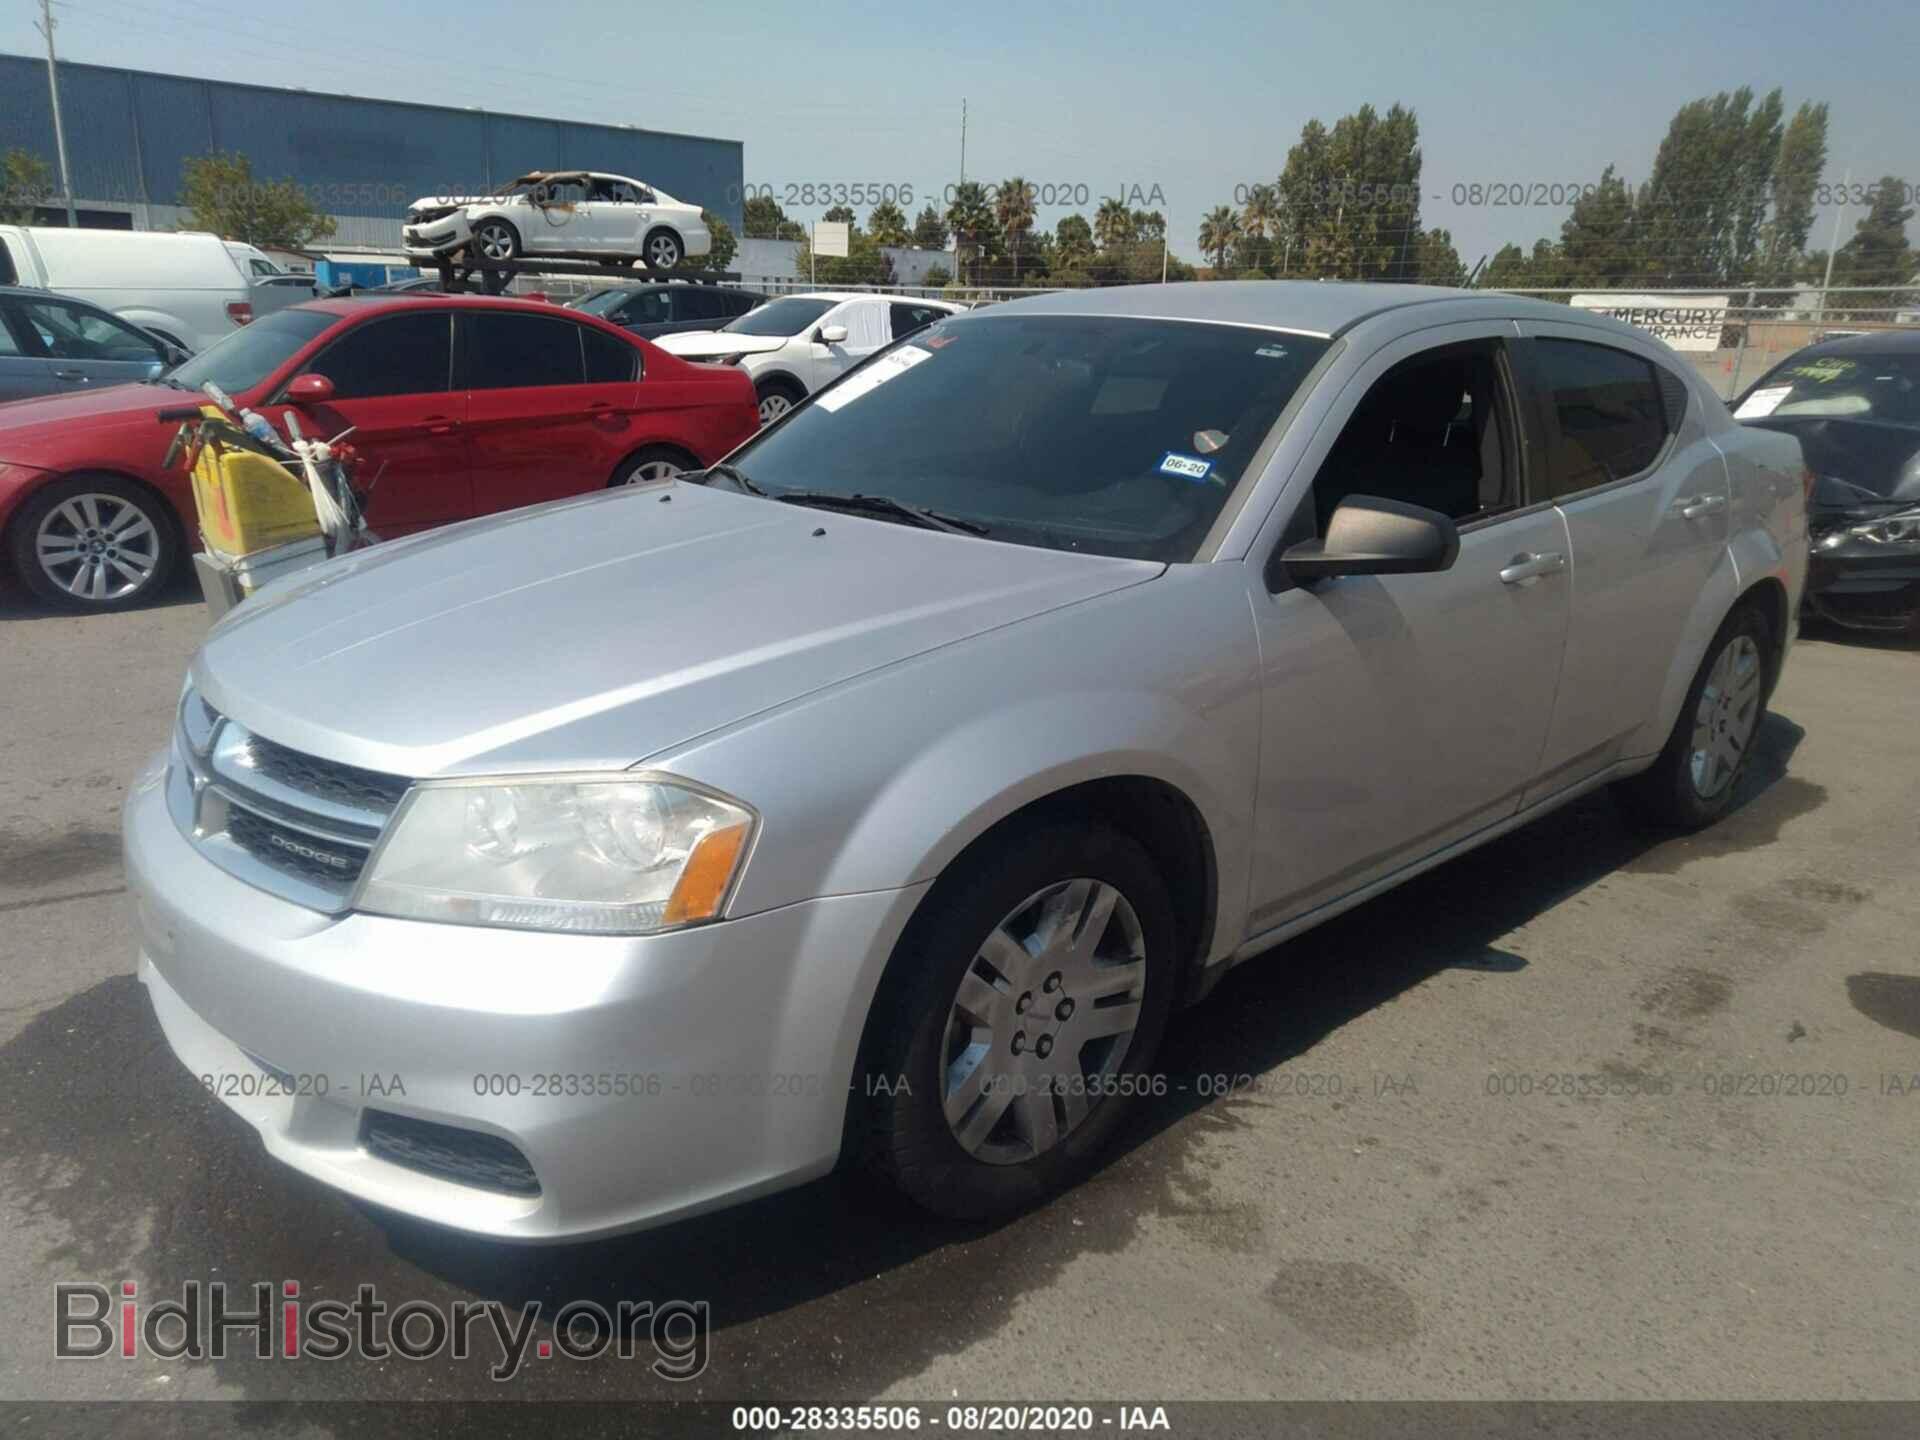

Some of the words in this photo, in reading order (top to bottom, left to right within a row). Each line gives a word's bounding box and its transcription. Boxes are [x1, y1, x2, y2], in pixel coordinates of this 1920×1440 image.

[1614, 307, 1719, 324] MERCURY
[1165, 458, 1206, 474] 06-20
[271, 834, 347, 869] DODGE
